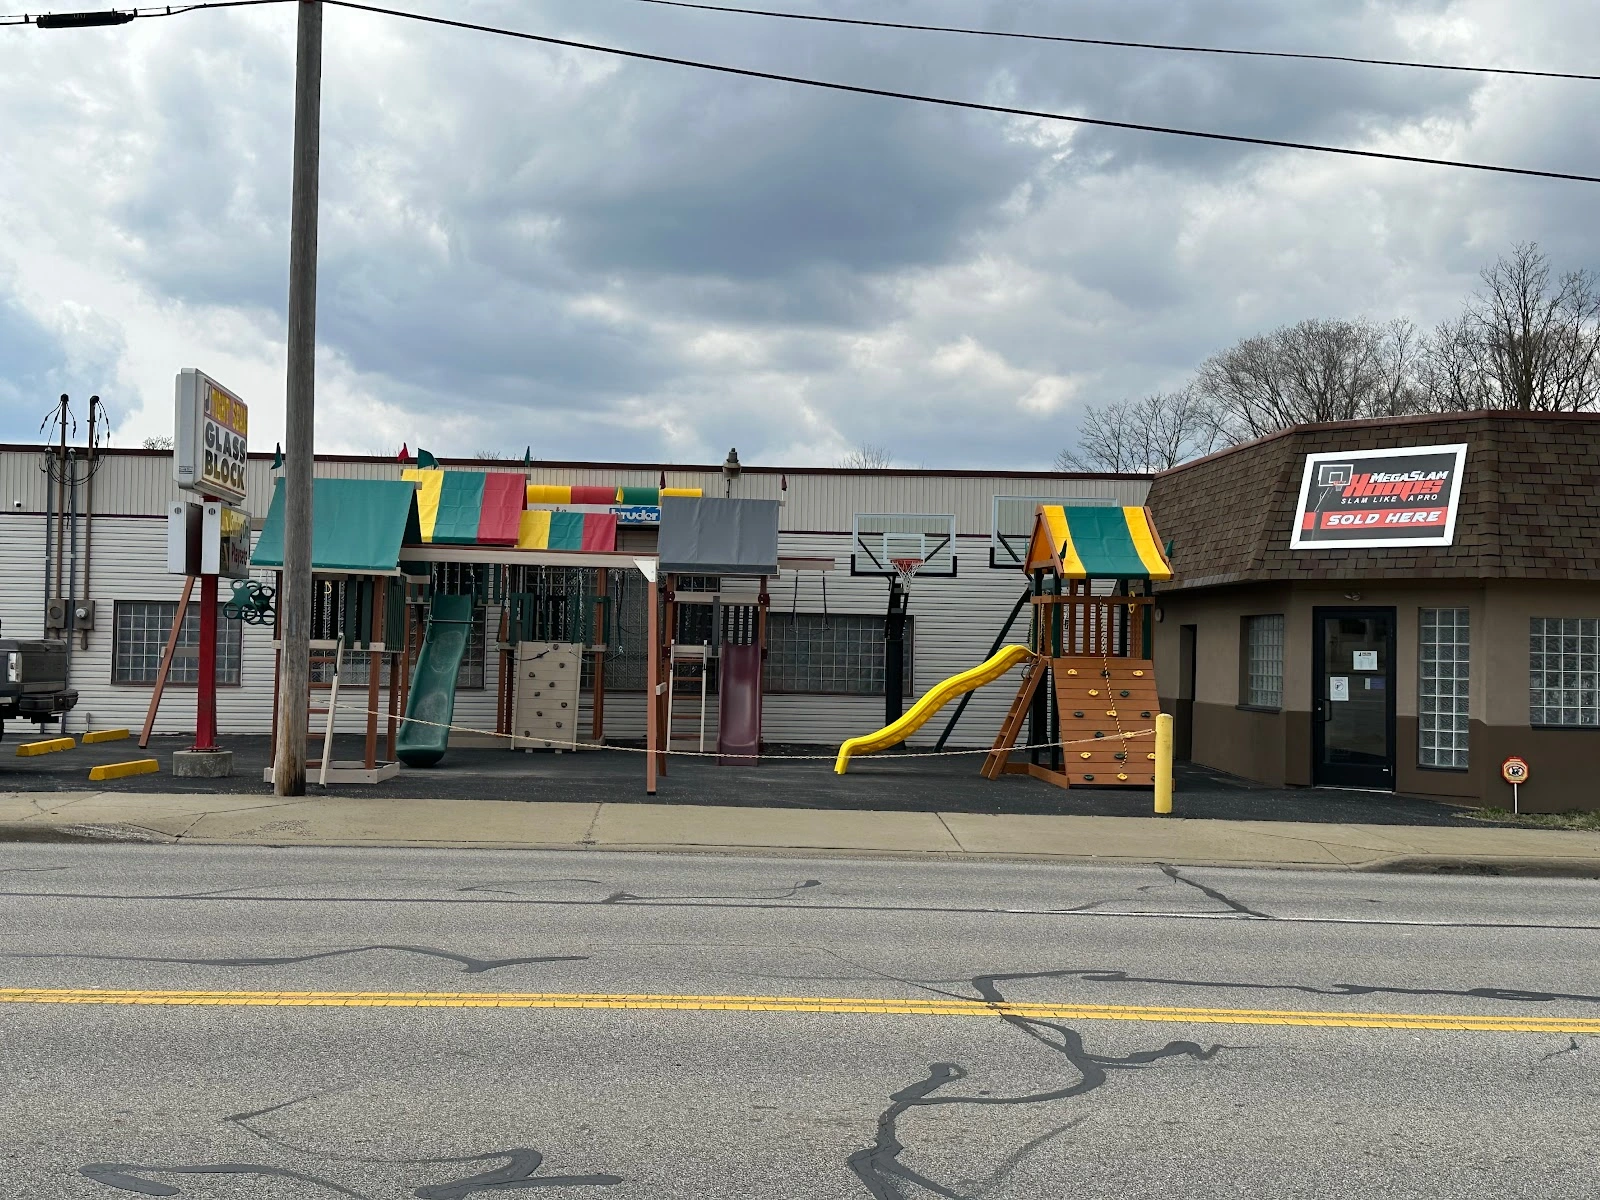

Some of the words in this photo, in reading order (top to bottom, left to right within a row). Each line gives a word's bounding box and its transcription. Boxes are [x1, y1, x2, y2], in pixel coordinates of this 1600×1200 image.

[205, 421, 246, 464] GLASS
[204, 448, 245, 490] BLOCK
[1373, 495, 1398, 503] LIKE
[1327, 513, 1380, 526] SOLD
[1385, 511, 1442, 524] HERE
